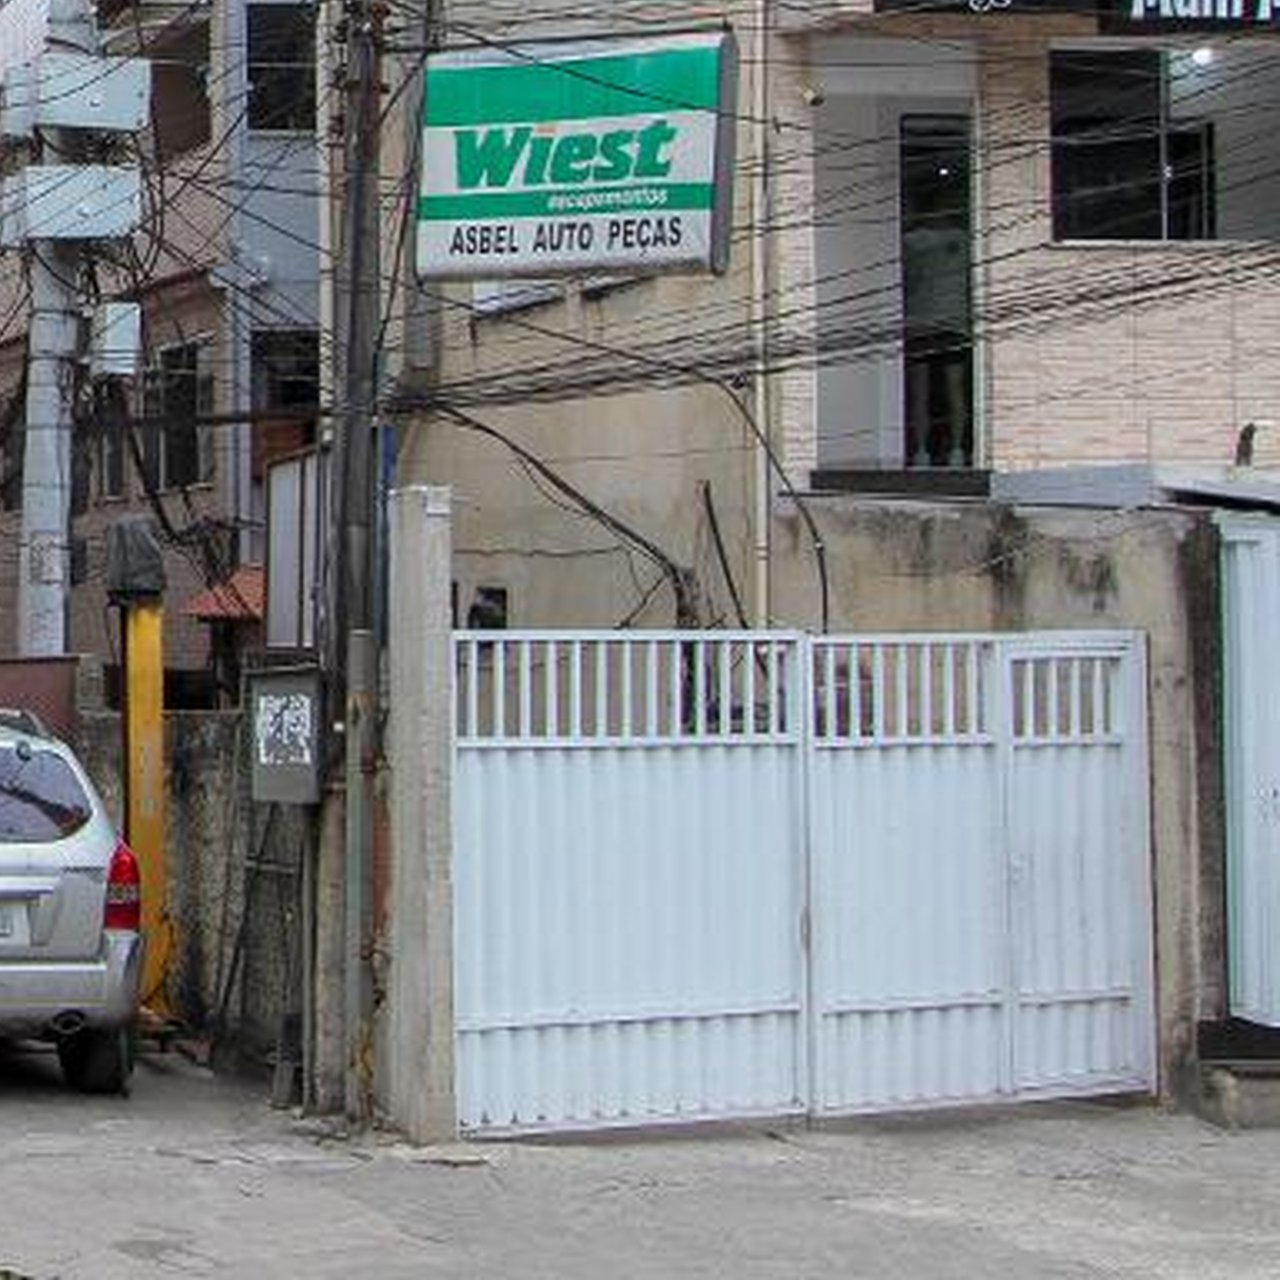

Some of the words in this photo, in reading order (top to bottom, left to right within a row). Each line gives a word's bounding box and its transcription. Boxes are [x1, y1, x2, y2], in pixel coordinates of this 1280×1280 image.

[453, 120, 677, 188] Wiest
[449, 225, 518, 255] ASBEL
[532, 222, 595, 253] AUTO
[607, 217, 682, 257] PEÇAS
